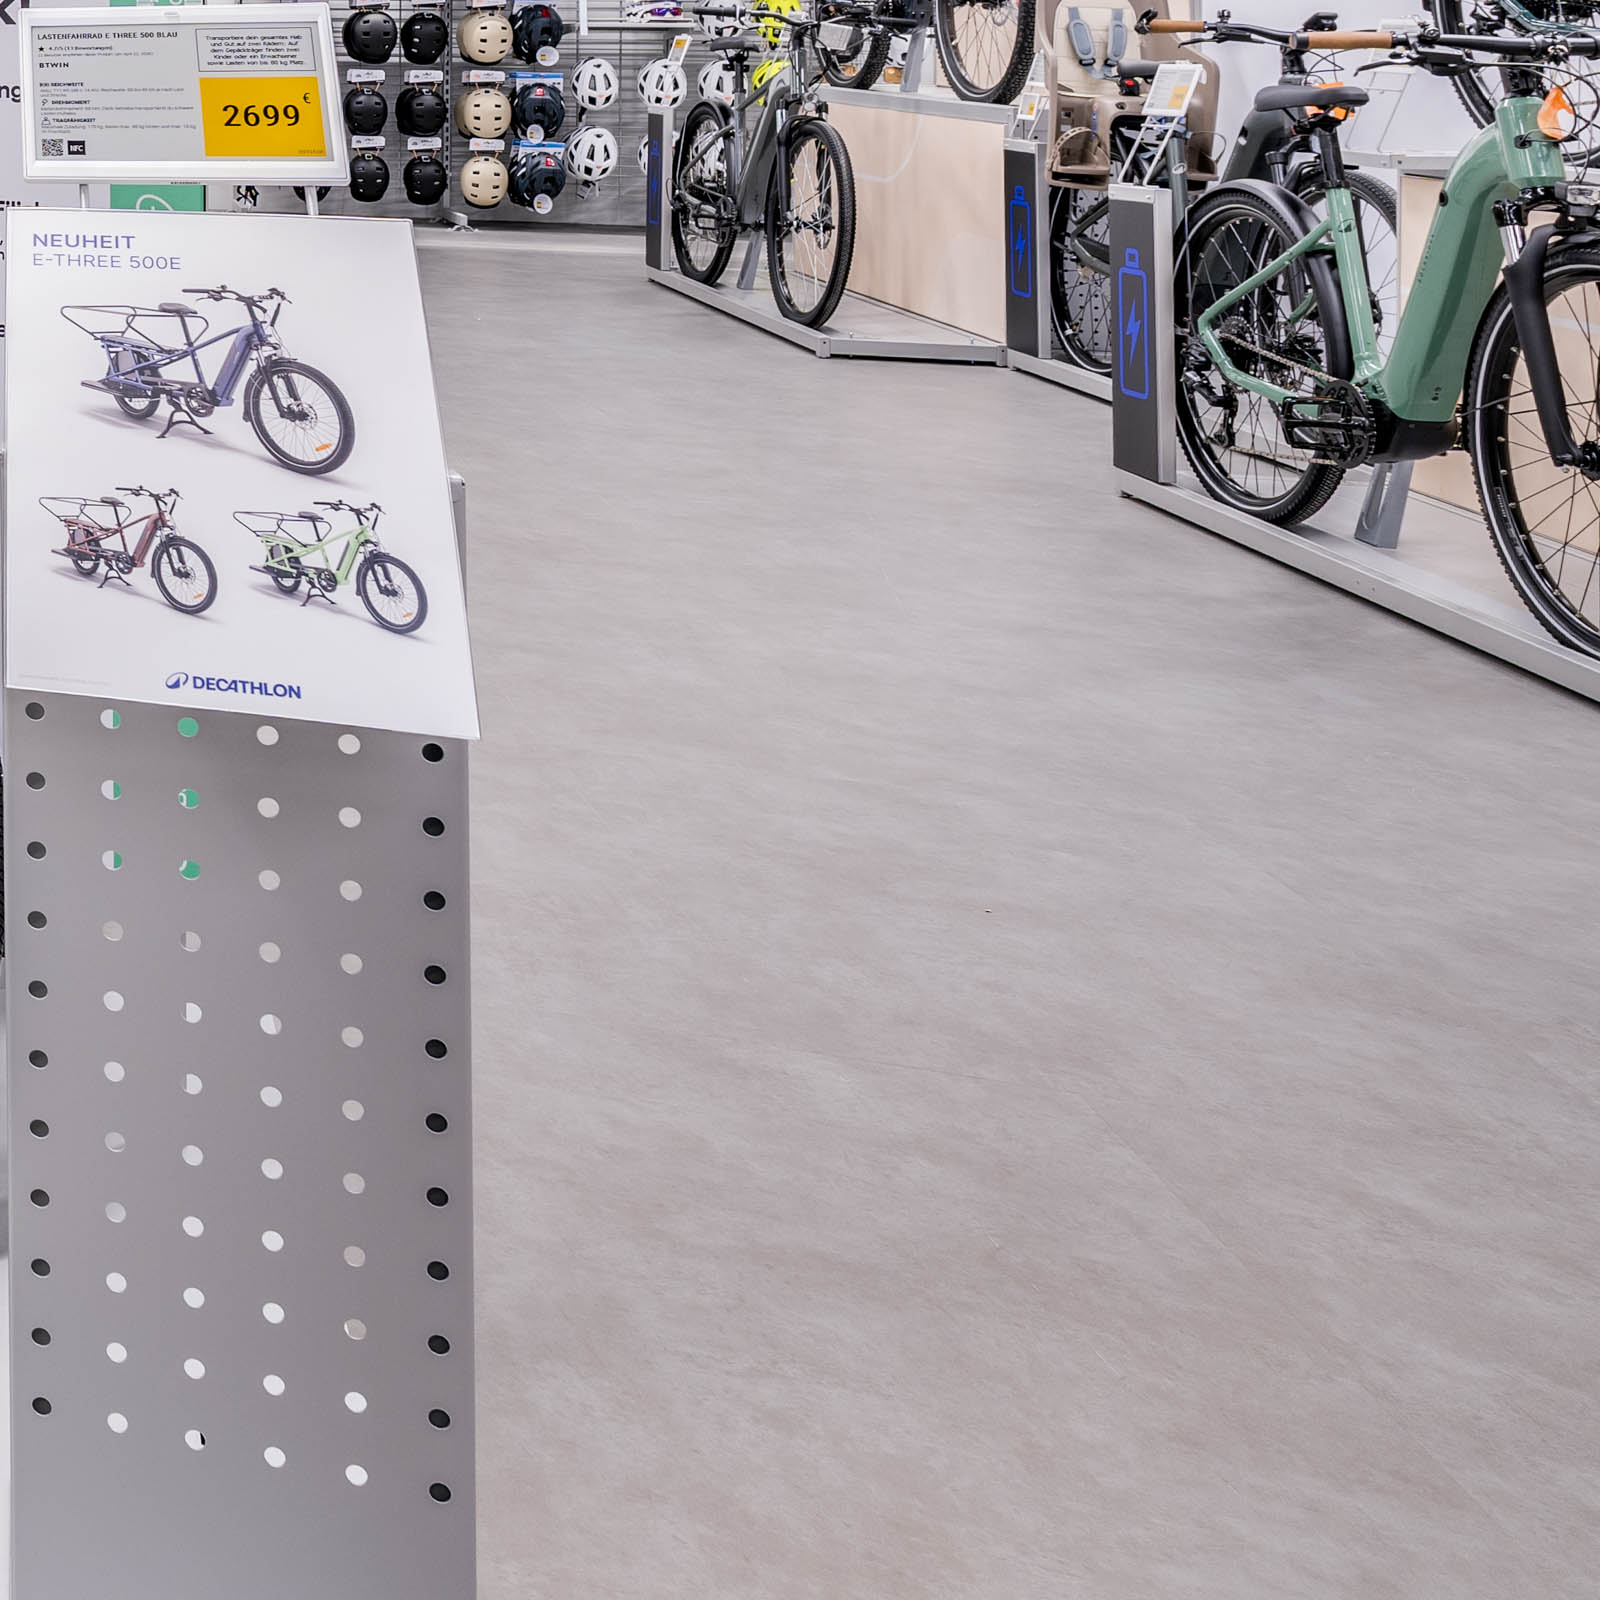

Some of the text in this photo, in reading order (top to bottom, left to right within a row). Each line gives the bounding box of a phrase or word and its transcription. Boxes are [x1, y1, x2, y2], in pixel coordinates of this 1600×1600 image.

[222, 104, 300, 127] 2699
[32, 233, 135, 249] NEUHEIT
[32, 253, 181, 271] E-THREE 500E
[193, 675, 301, 700] DECATHLON
